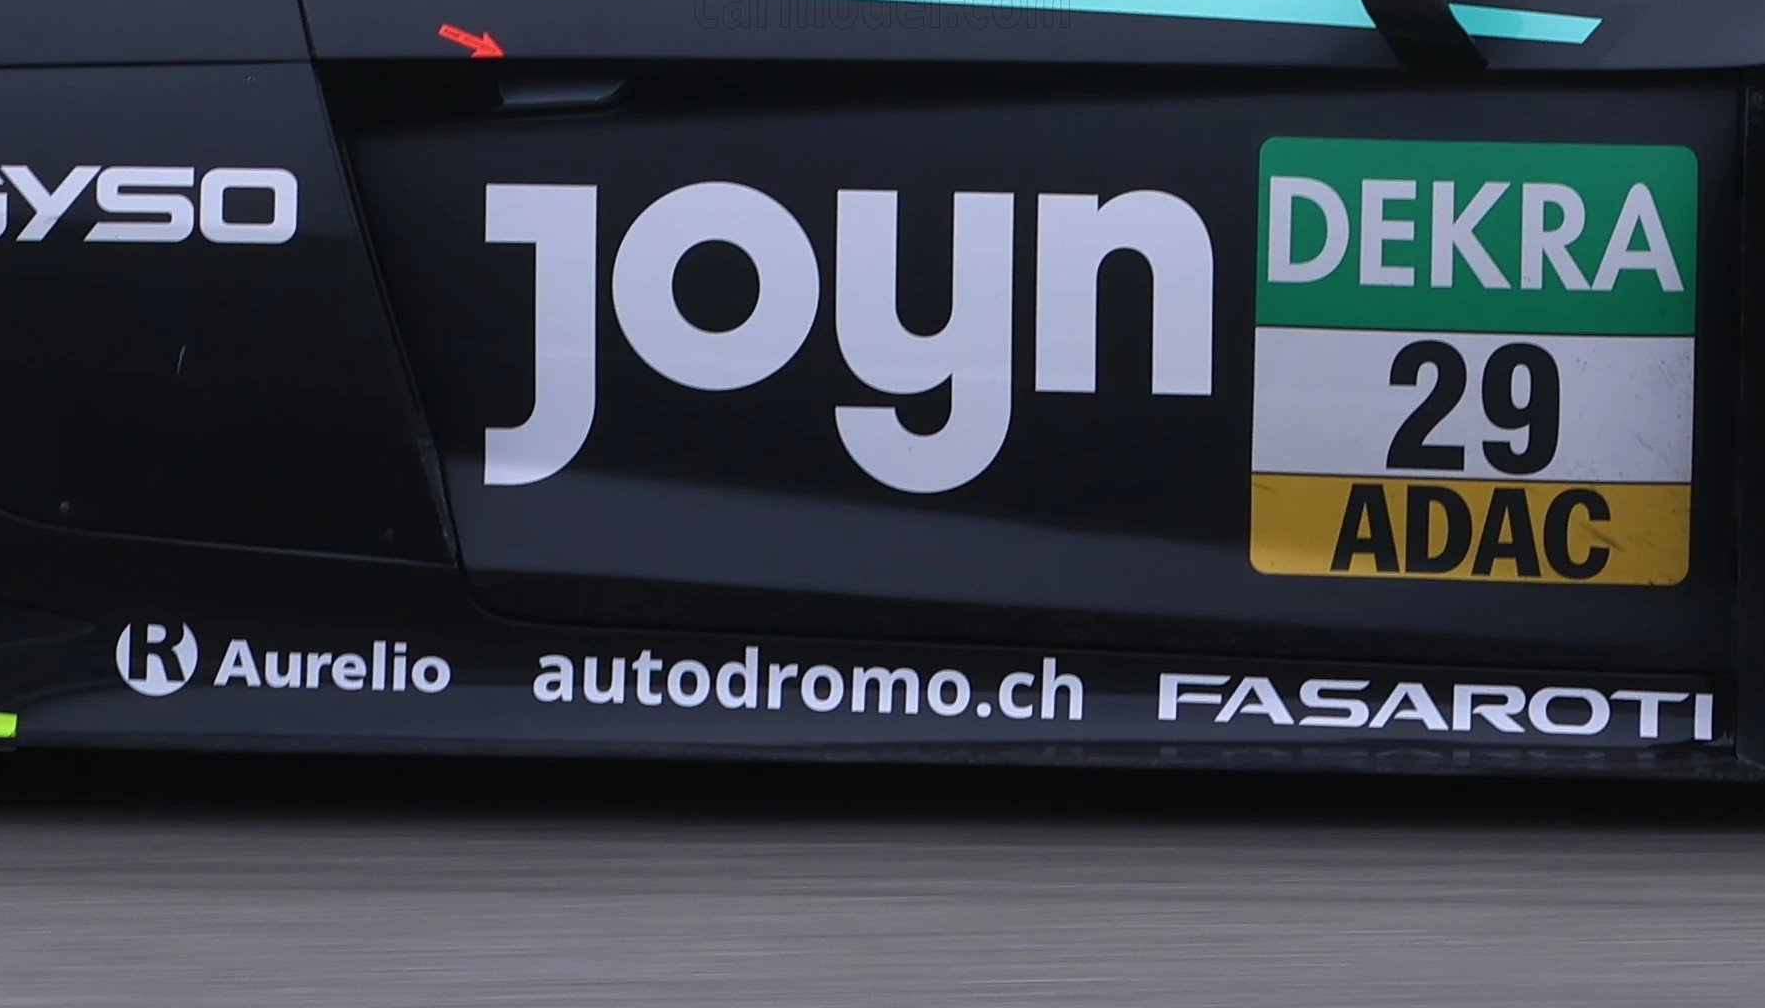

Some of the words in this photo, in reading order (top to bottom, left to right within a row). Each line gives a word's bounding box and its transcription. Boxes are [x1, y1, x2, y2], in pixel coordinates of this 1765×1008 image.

[1267, 175, 1685, 293] DEKRA
[483, 180, 1215, 494] joyn
[1385, 339, 1561, 476] 29
[1330, 482, 1613, 580] ADAC
[213, 638, 452, 695] Aurelio
[532, 645, 1084, 721] autodromo.ch
[1157, 672, 1714, 742] FASAROTI
